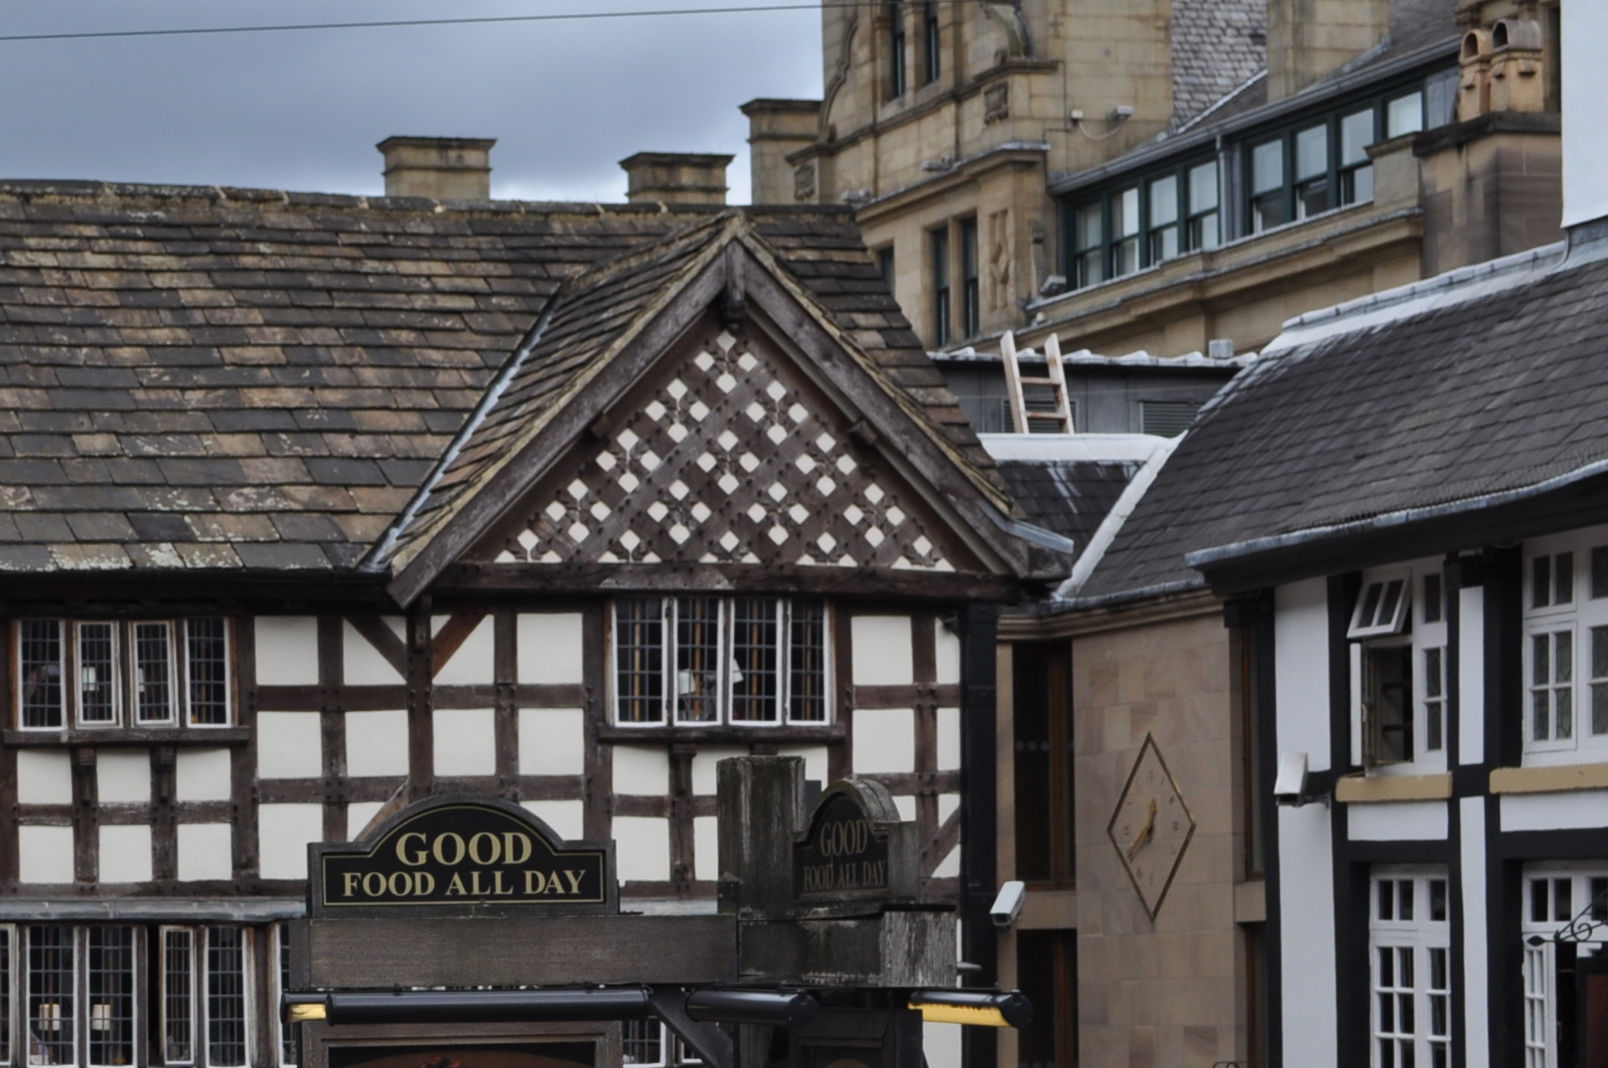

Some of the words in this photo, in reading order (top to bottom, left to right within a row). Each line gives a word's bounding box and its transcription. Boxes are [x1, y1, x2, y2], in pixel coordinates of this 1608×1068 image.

[395, 832, 532, 866] GOOD
[821, 819, 868, 856] GOOD
[342, 872, 435, 897] FOOD
[445, 871, 514, 896] ALL
[523, 869, 586, 894] DAY
[804, 864, 833, 890] FOOD
[840, 863, 858, 888] ALL
[863, 861, 885, 887] DAY
